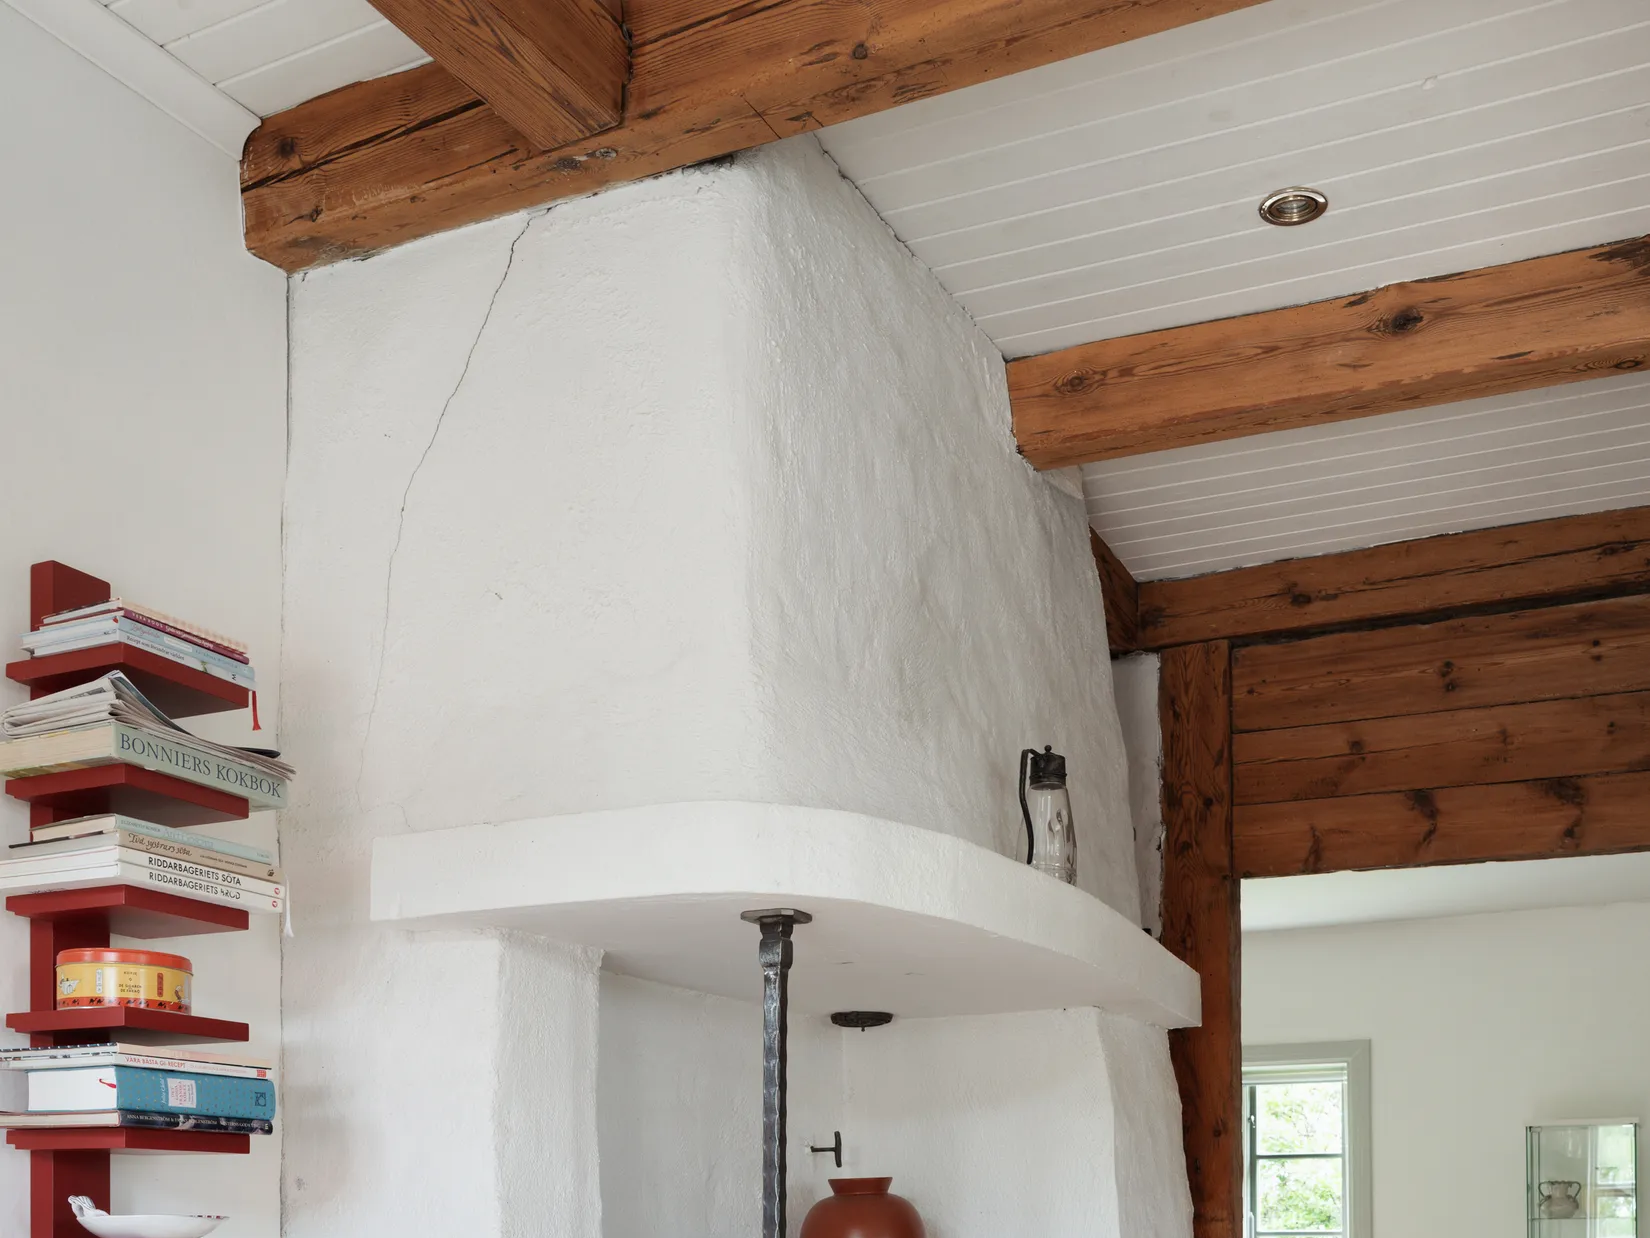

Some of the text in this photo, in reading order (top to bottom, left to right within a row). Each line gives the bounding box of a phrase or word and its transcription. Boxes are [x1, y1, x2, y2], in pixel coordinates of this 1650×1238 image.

[120, 732, 282, 798] BONNIERS KOKBOK
[146, 839, 175, 854] systrars
[148, 857, 219, 881] RIDDARBAGERIETS
[222, 873, 241, 886] SÖTA
[149, 872, 219, 895] RIDDARBAGERIETS
[142, 1057, 158, 1066] BÄSTA
